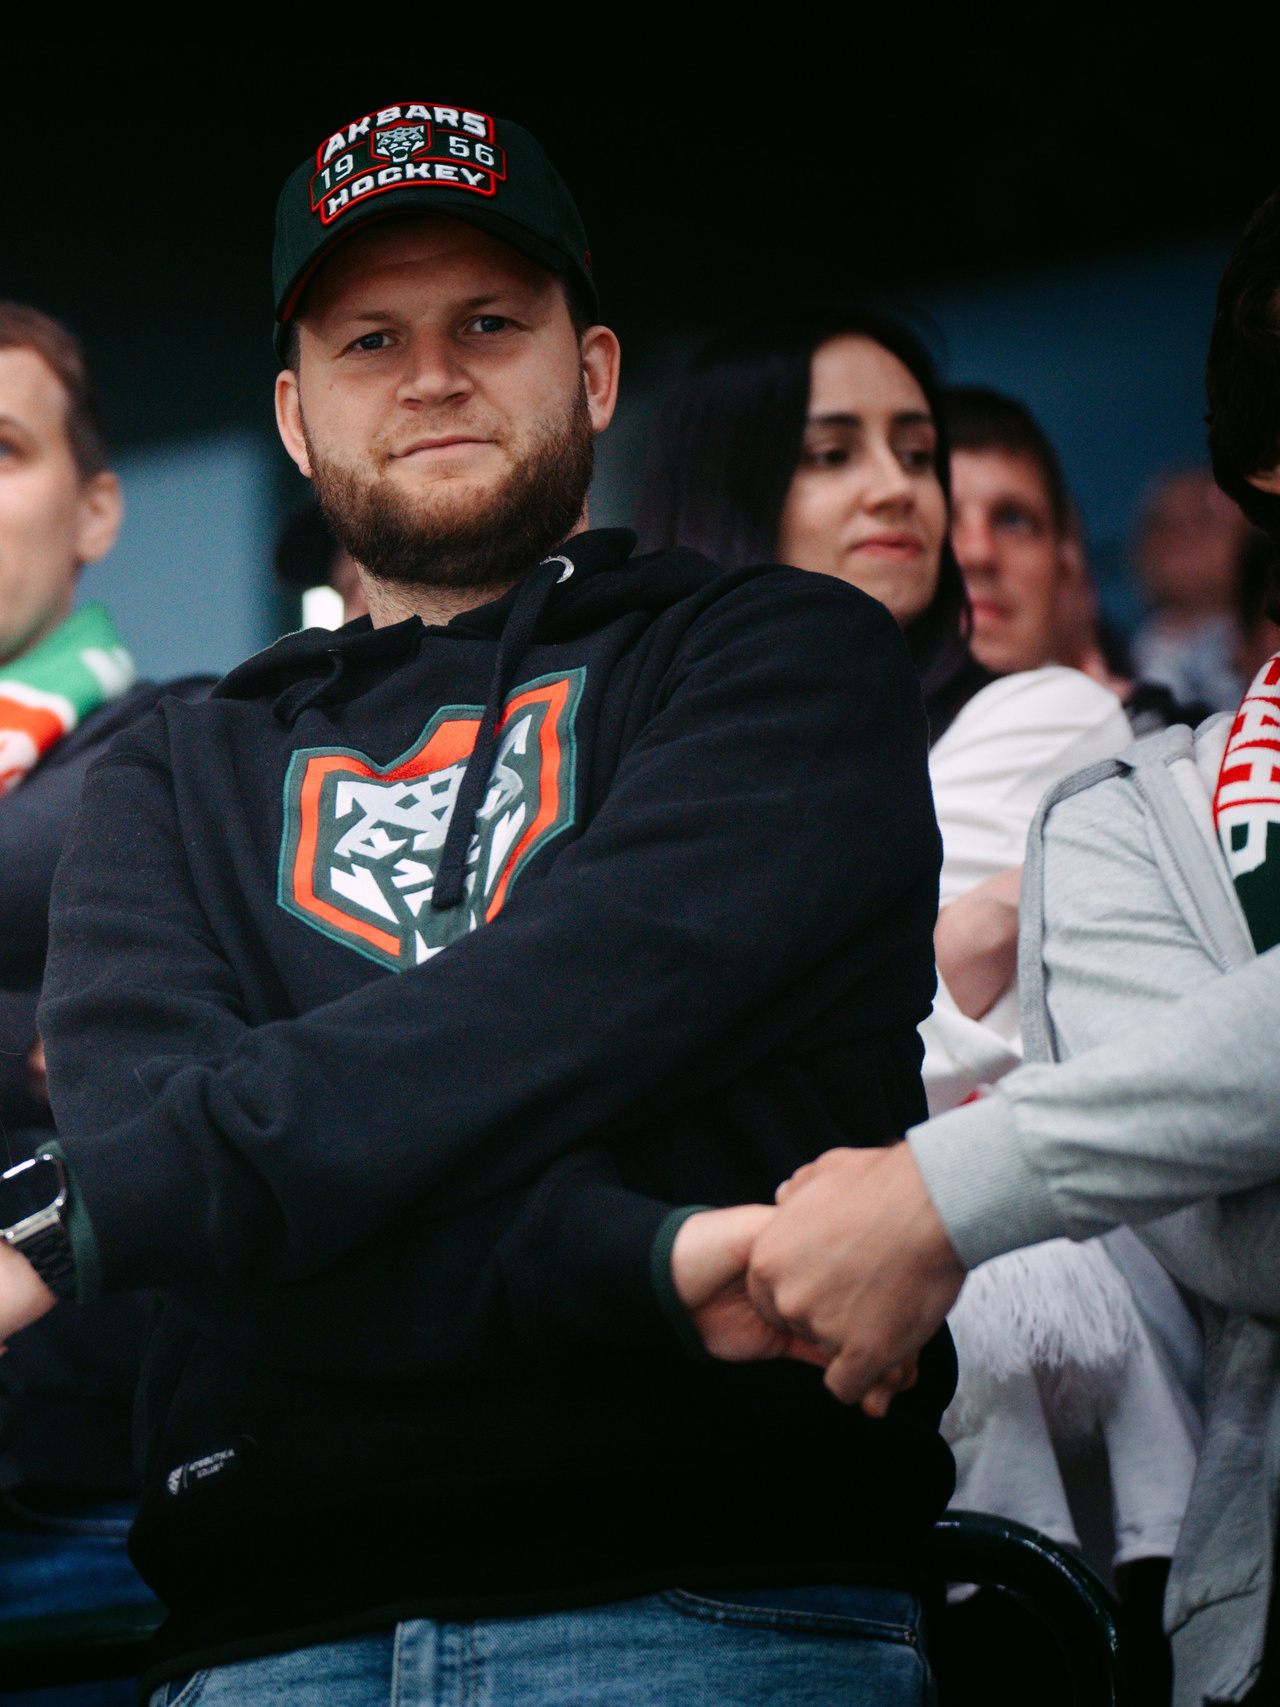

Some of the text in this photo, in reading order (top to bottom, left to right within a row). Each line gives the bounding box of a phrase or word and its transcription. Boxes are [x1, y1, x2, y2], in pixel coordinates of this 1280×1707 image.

[321, 136, 495, 190] 19 56
[327, 163, 486, 216] HOCKEY
